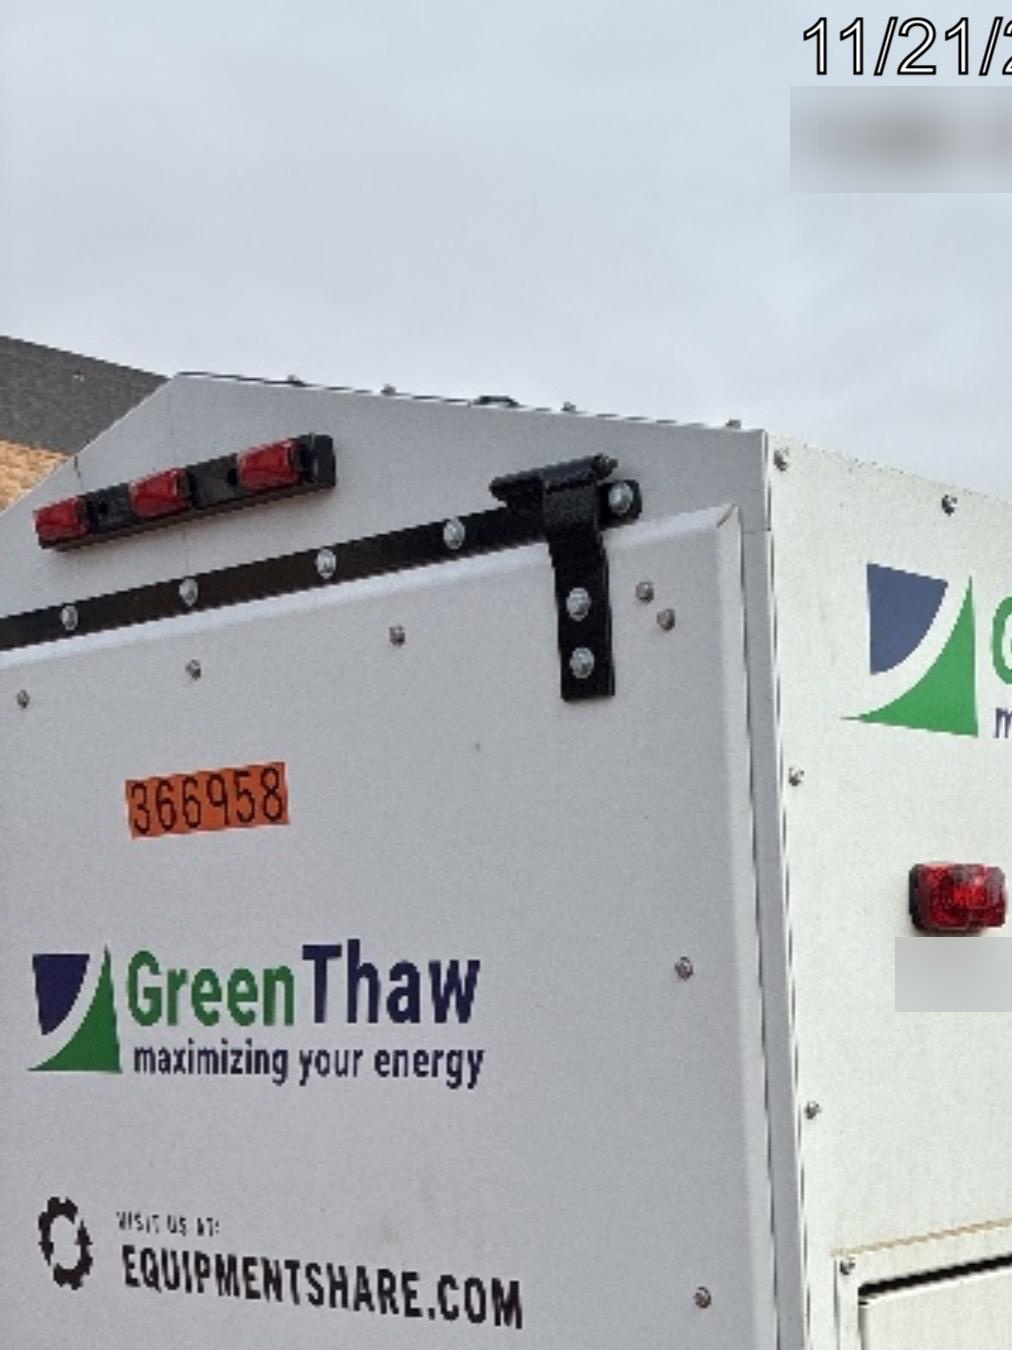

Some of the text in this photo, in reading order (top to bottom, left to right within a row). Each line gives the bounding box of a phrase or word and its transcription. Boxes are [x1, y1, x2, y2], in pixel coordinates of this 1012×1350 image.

[131, 767, 285, 834] 366958
[126, 938, 481, 1027] GreenThaw
[133, 1038, 486, 1090] maximizing your energy
[115, 1211, 220, 1238] VISIT US AT:
[121, 1243, 523, 1331] EQUIPMENTSHARE.COM
